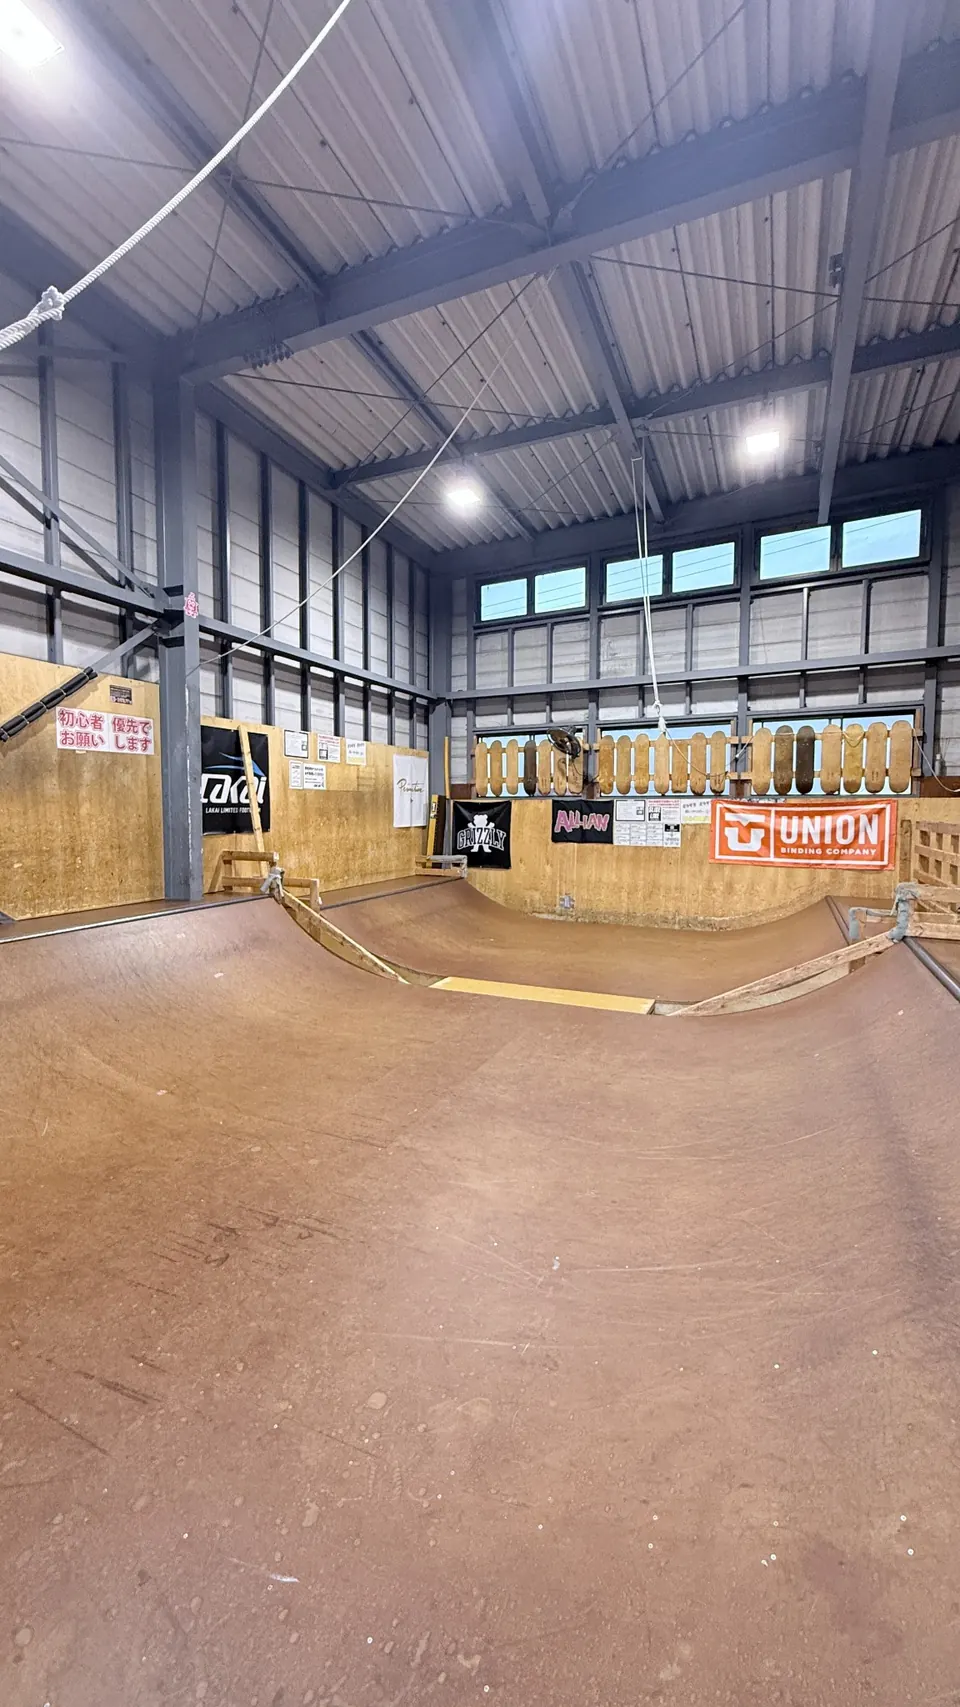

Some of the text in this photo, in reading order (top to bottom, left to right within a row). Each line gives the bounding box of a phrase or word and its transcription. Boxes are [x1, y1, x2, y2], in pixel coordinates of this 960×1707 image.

[58, 709, 152, 735] 初心者 優先で
[60, 730, 152, 752] お願い します
[456, 827, 507, 851] GRIZZLY
[780, 814, 879, 844] UNION
[781, 847, 877, 856] BINDING COMPANY
